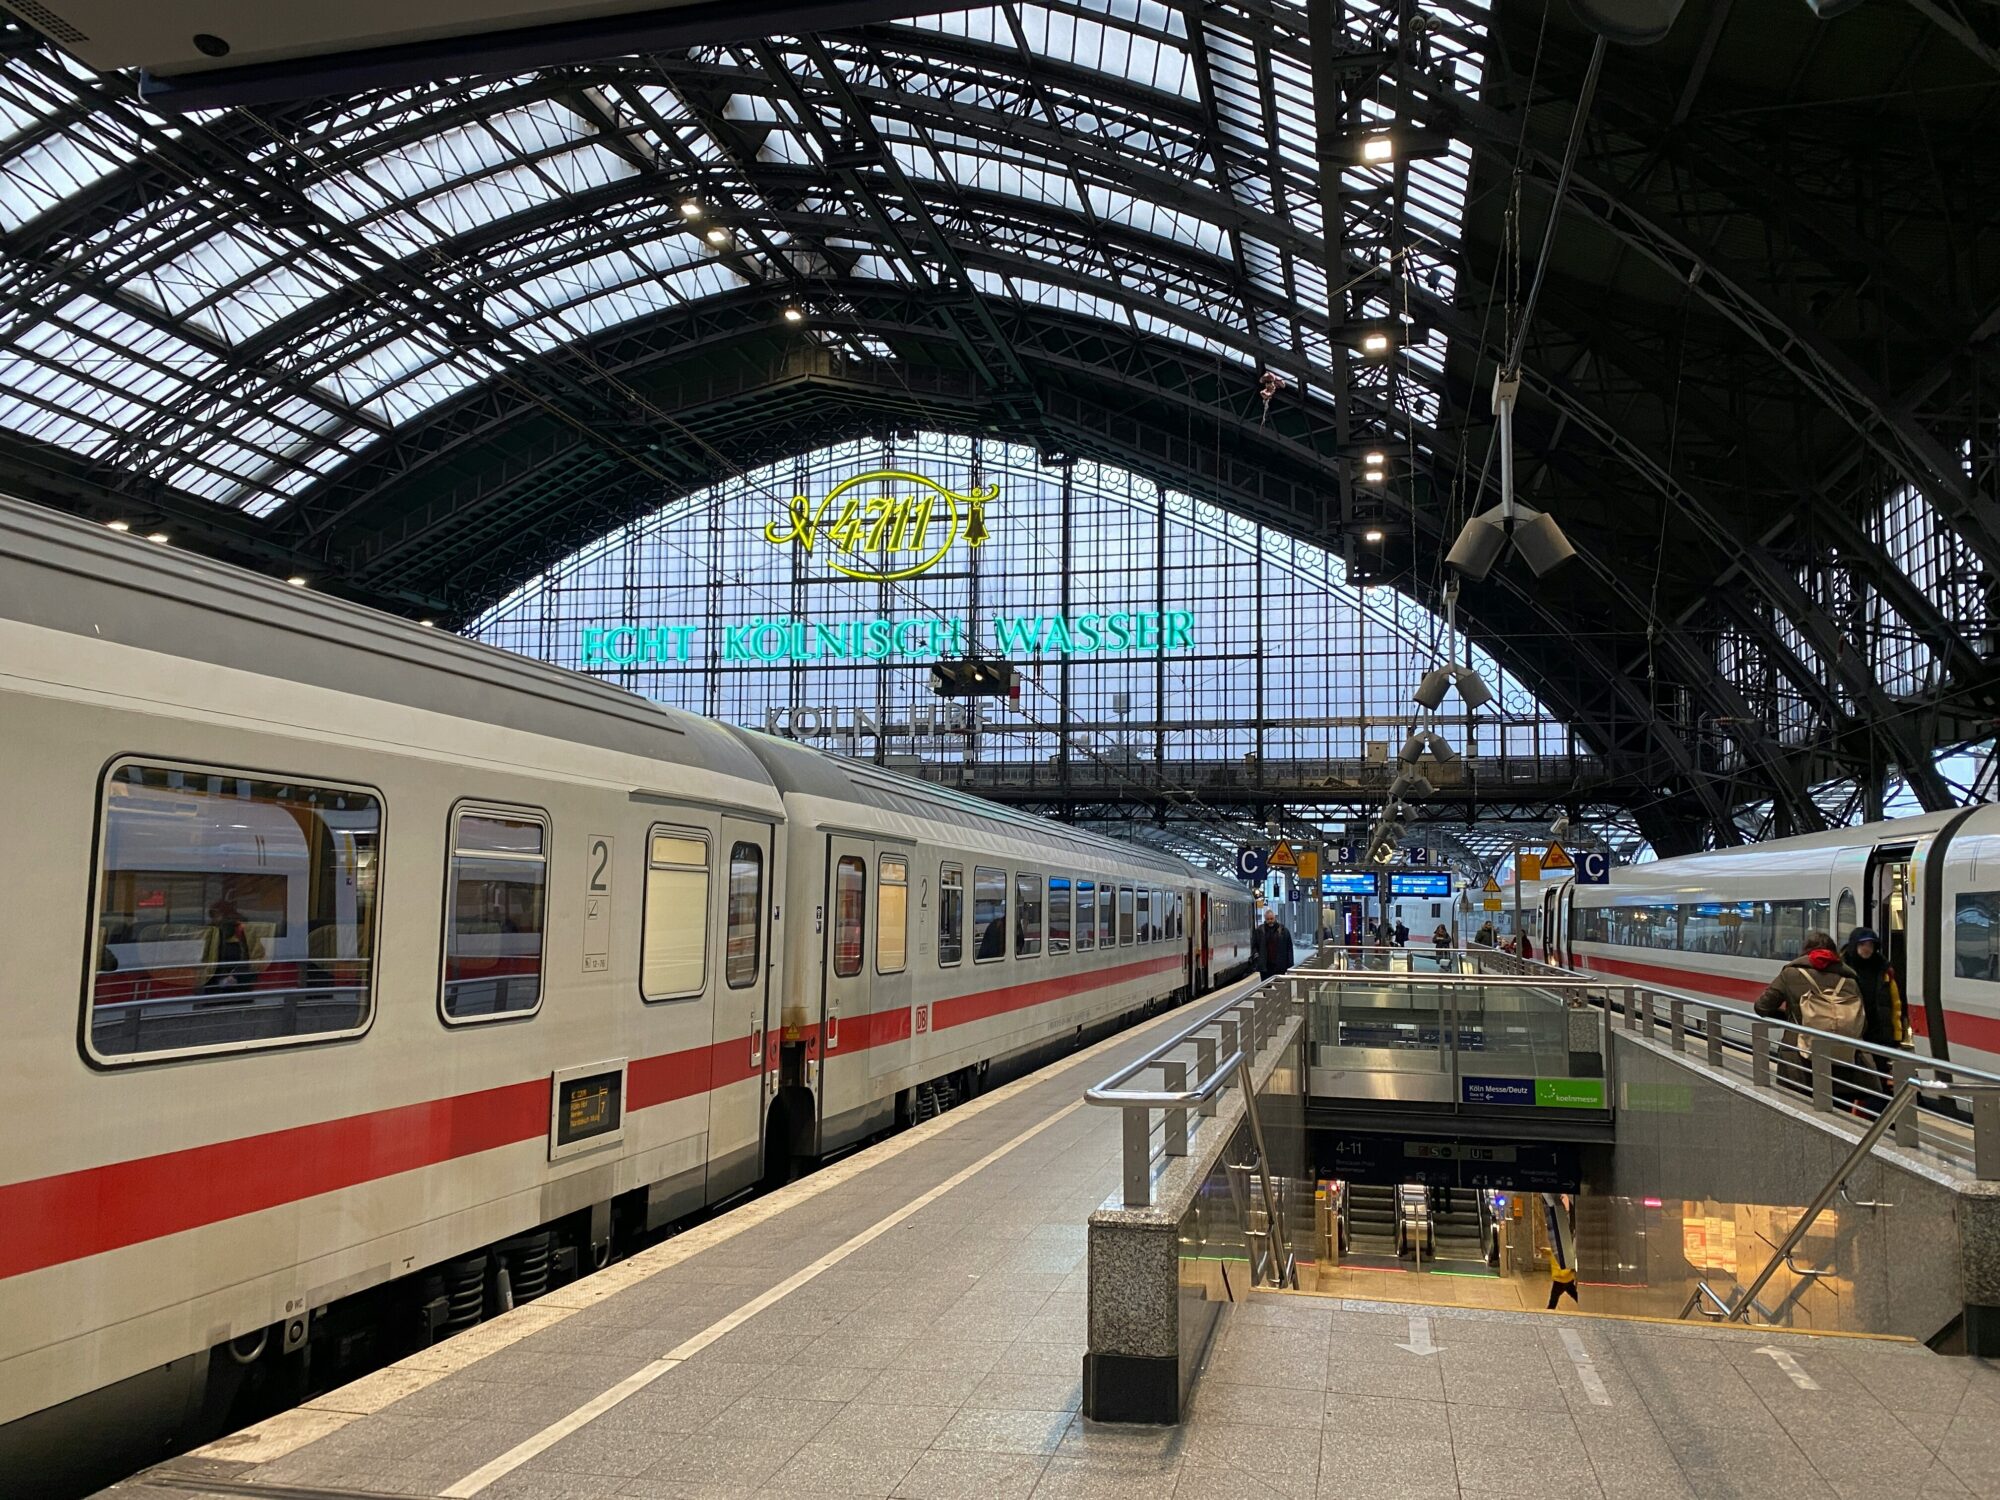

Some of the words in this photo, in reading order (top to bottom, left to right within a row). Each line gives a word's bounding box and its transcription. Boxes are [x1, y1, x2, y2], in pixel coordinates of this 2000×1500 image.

[828, 495, 936, 554] 4711
[581, 623, 697, 665] ECHT
[723, 615, 961, 662] KÖLNISCH
[995, 609, 1196, 655] WASSER
[765, 703, 882, 739] KÖLN
[1340, 847, 1349, 860] 3
[1416, 847, 1426, 860] 2
[590, 840, 608, 891] 2
[1241, 850, 1258, 874] C
[1585, 853, 1604, 877] C
[921, 878, 928, 908] 2
[1291, 891, 1299, 900] B
[917, 1009, 927, 1030] DB
[1485, 1085, 1528, 1094] Messe/Deutz
[1556, 1095, 1598, 1103] koelnmesse
[1336, 1141, 1362, 1155] 4-11
[1431, 1147, 1439, 1157] S
[1471, 1149, 1480, 1159] U
[1551, 1152, 1557, 1165] 1
